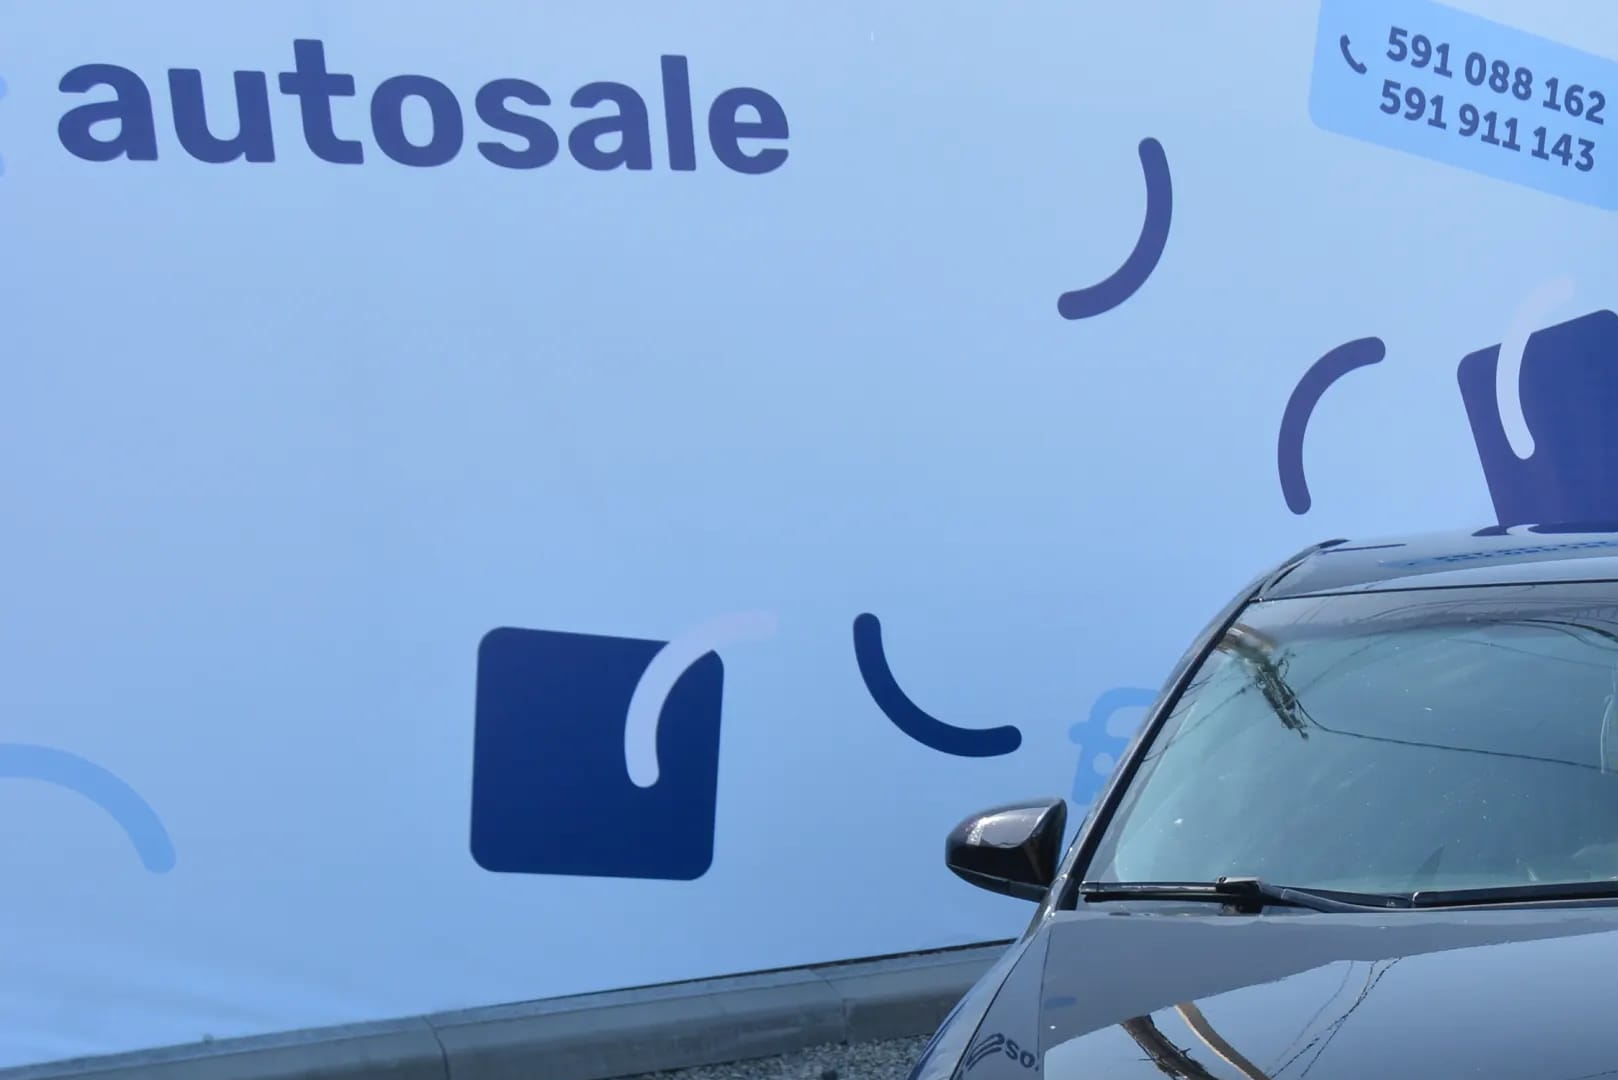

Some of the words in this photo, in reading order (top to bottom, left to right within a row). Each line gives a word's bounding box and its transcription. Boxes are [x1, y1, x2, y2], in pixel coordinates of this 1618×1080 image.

[58, 39, 790, 175] autosale
[1380, 79, 1447, 130] 591
[1458, 104, 1521, 153] 911
[1531, 126, 1596, 173] 143
[1386, 26, 1453, 78] 591
[1465, 52, 1533, 102] 088
[1543, 77, 1607, 126] 162
